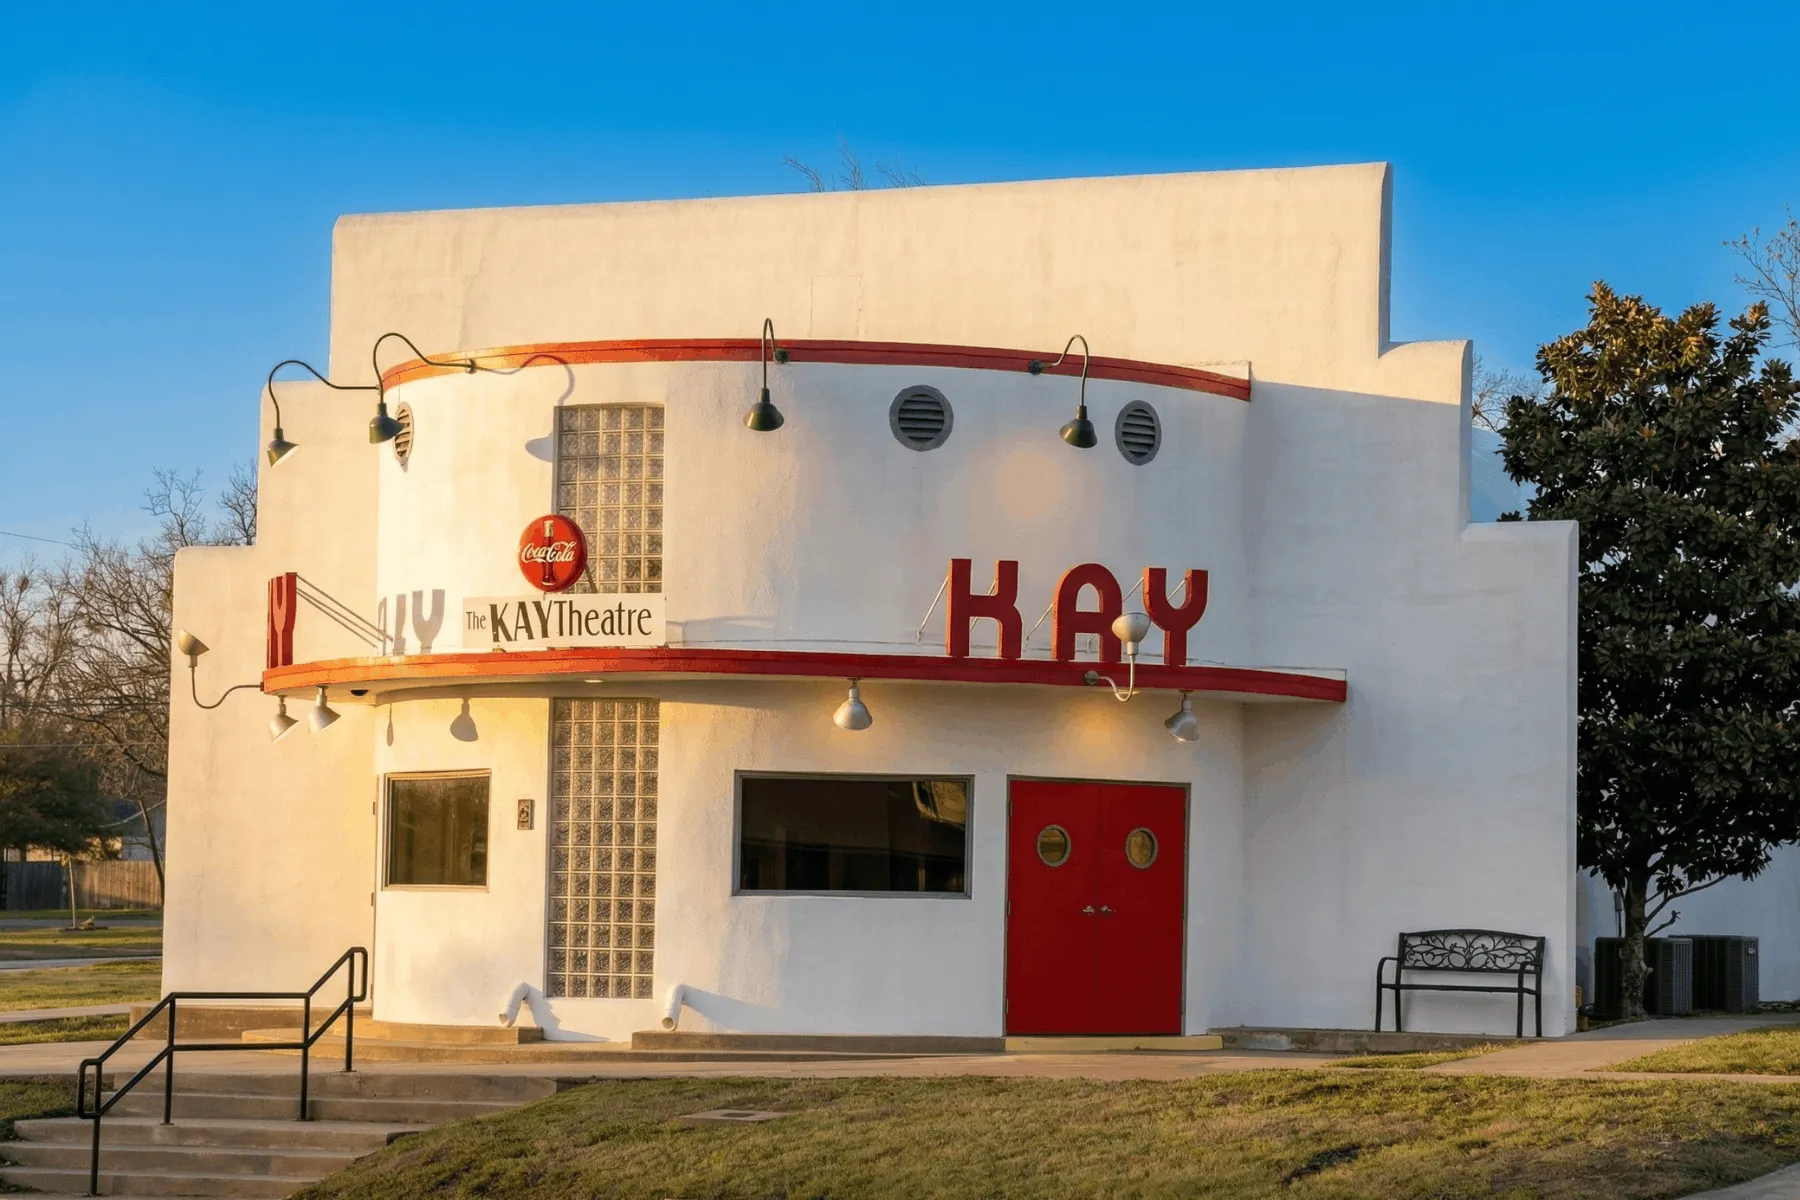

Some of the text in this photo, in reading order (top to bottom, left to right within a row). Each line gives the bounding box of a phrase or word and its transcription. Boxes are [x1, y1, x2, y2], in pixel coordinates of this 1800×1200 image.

[465, 611, 486, 630] The
[489, 600, 553, 642] KAY
[553, 599, 652, 637] Theatre
[946, 558, 1209, 667] KAY
